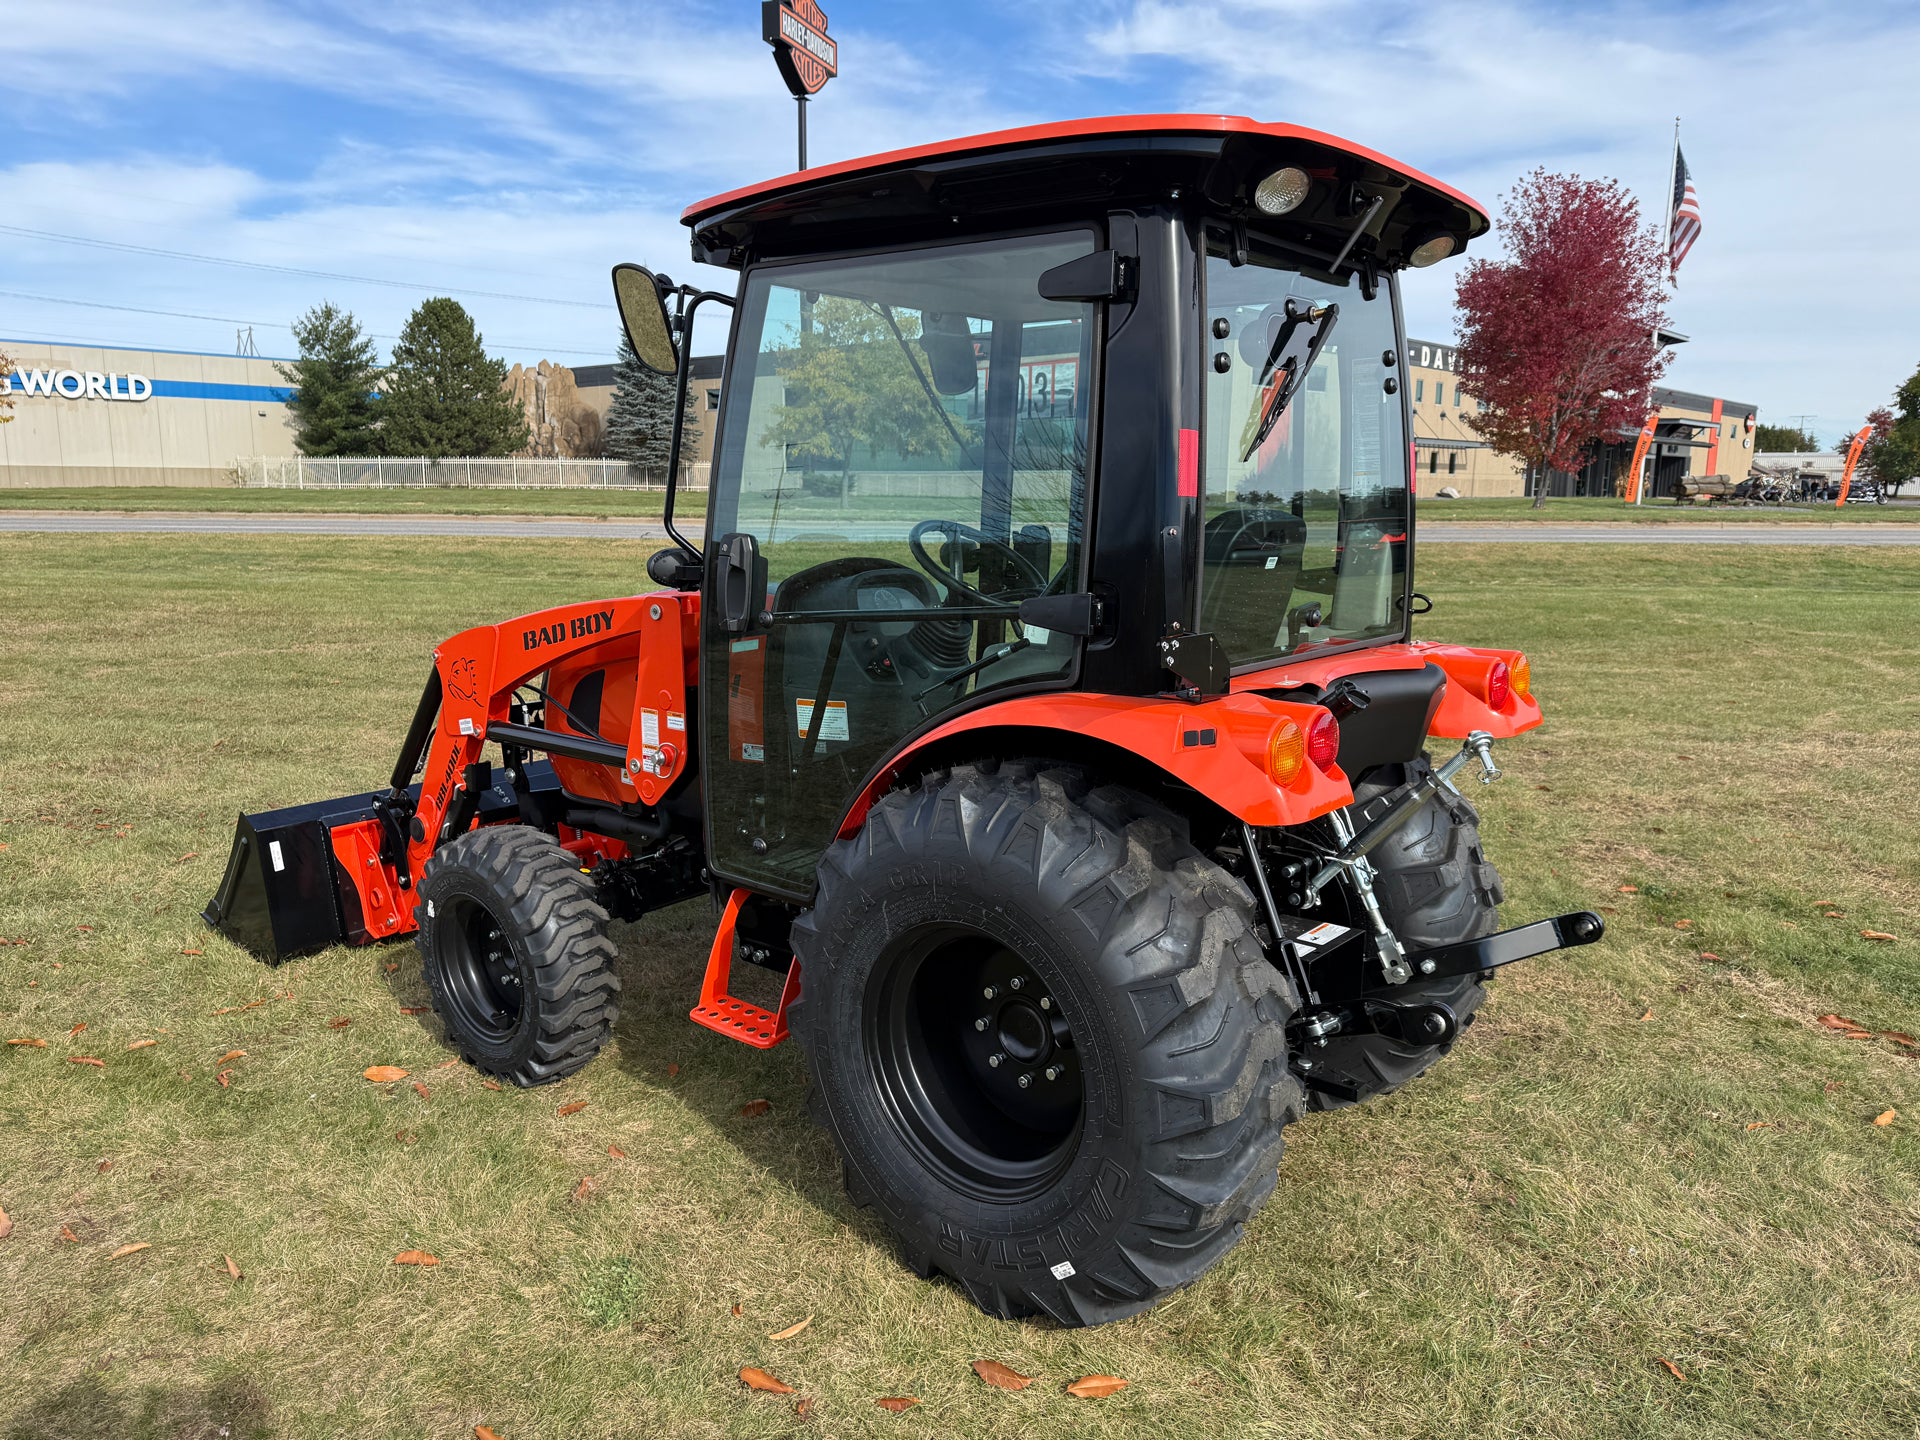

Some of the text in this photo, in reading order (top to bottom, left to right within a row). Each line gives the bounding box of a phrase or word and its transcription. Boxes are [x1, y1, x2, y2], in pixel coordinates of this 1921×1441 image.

[782, 12, 834, 67] HARLEY-DAVIDSON
[15, 366, 152, 401] WORLD
[523, 608, 615, 651] BAD BOY
[937, 1158, 1130, 1274] CARLSTAR
